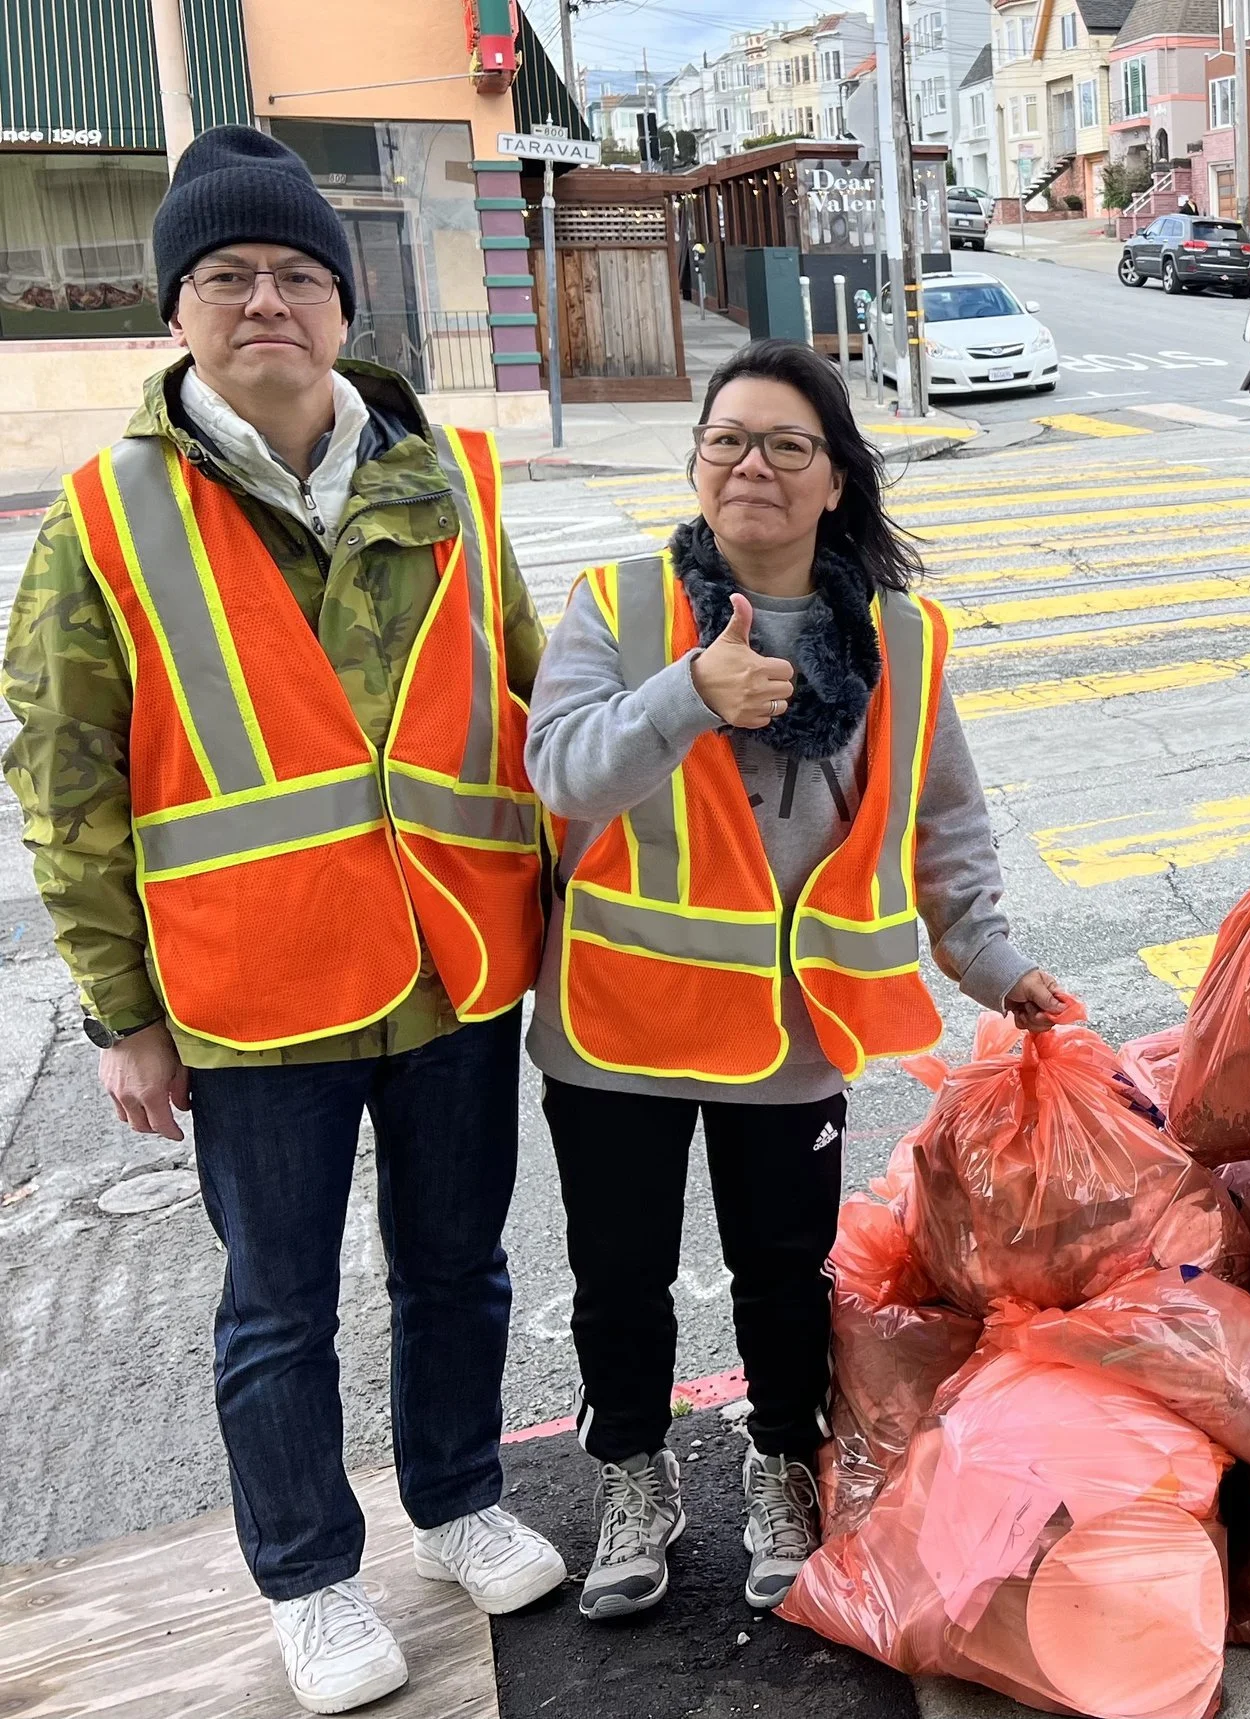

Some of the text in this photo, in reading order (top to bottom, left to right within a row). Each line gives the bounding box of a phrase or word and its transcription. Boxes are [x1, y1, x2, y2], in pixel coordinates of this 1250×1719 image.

[2, 129, 102, 144] nce 1969
[544, 128, 564, 138] 800
[502, 137, 595, 160] TARAVAL
[810, 168, 875, 191] Dear
[807, 190, 937, 213] Valene!
[1058, 351, 1229, 373] STOP
[813, 1129, 839, 1151] adidas
